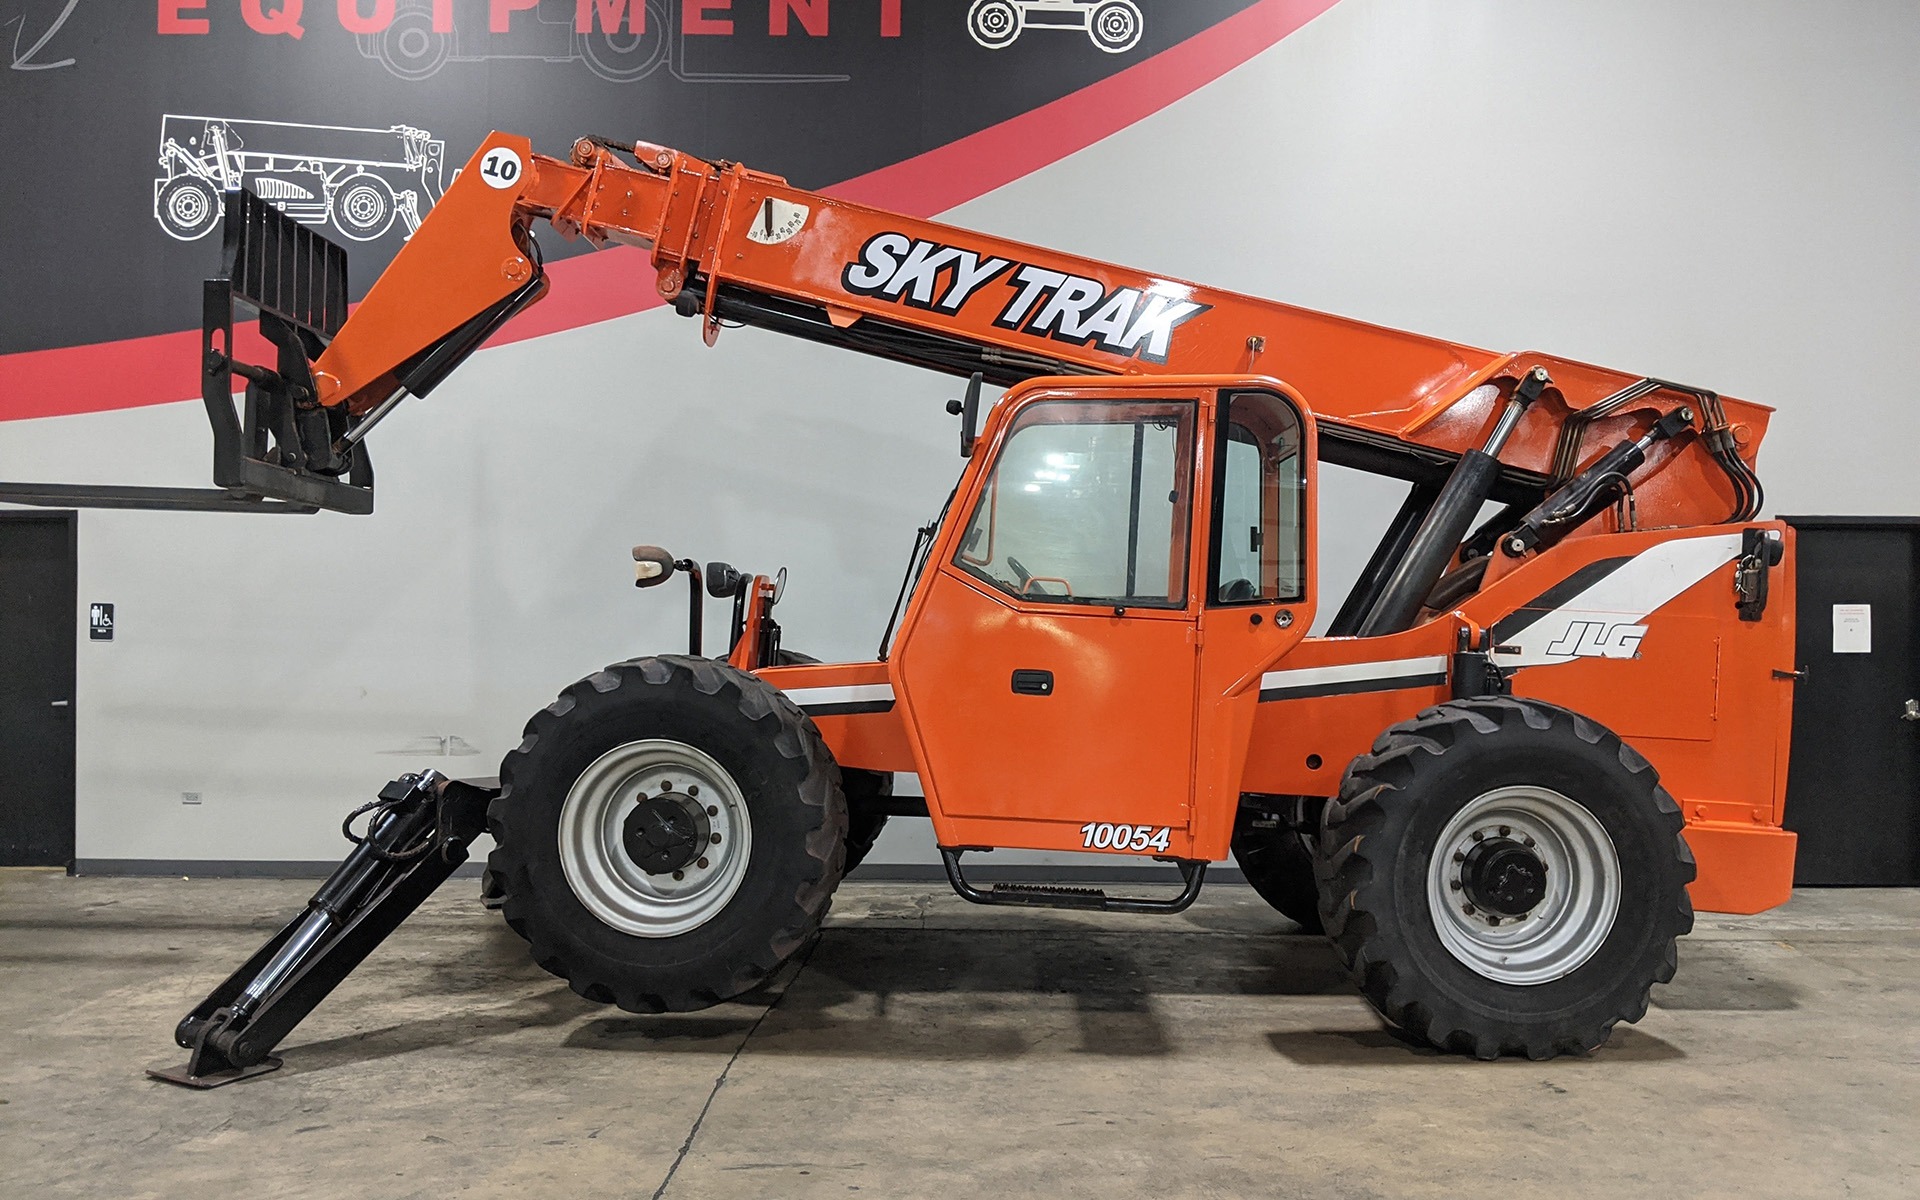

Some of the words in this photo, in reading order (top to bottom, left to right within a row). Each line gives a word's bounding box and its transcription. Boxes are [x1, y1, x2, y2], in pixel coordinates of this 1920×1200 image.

[483, 155, 517, 181] 10
[842, 232, 1014, 314] SKY
[994, 264, 1211, 364] TRAK
[1545, 620, 1650, 659] JLG
[1081, 821, 1171, 853] 10054
